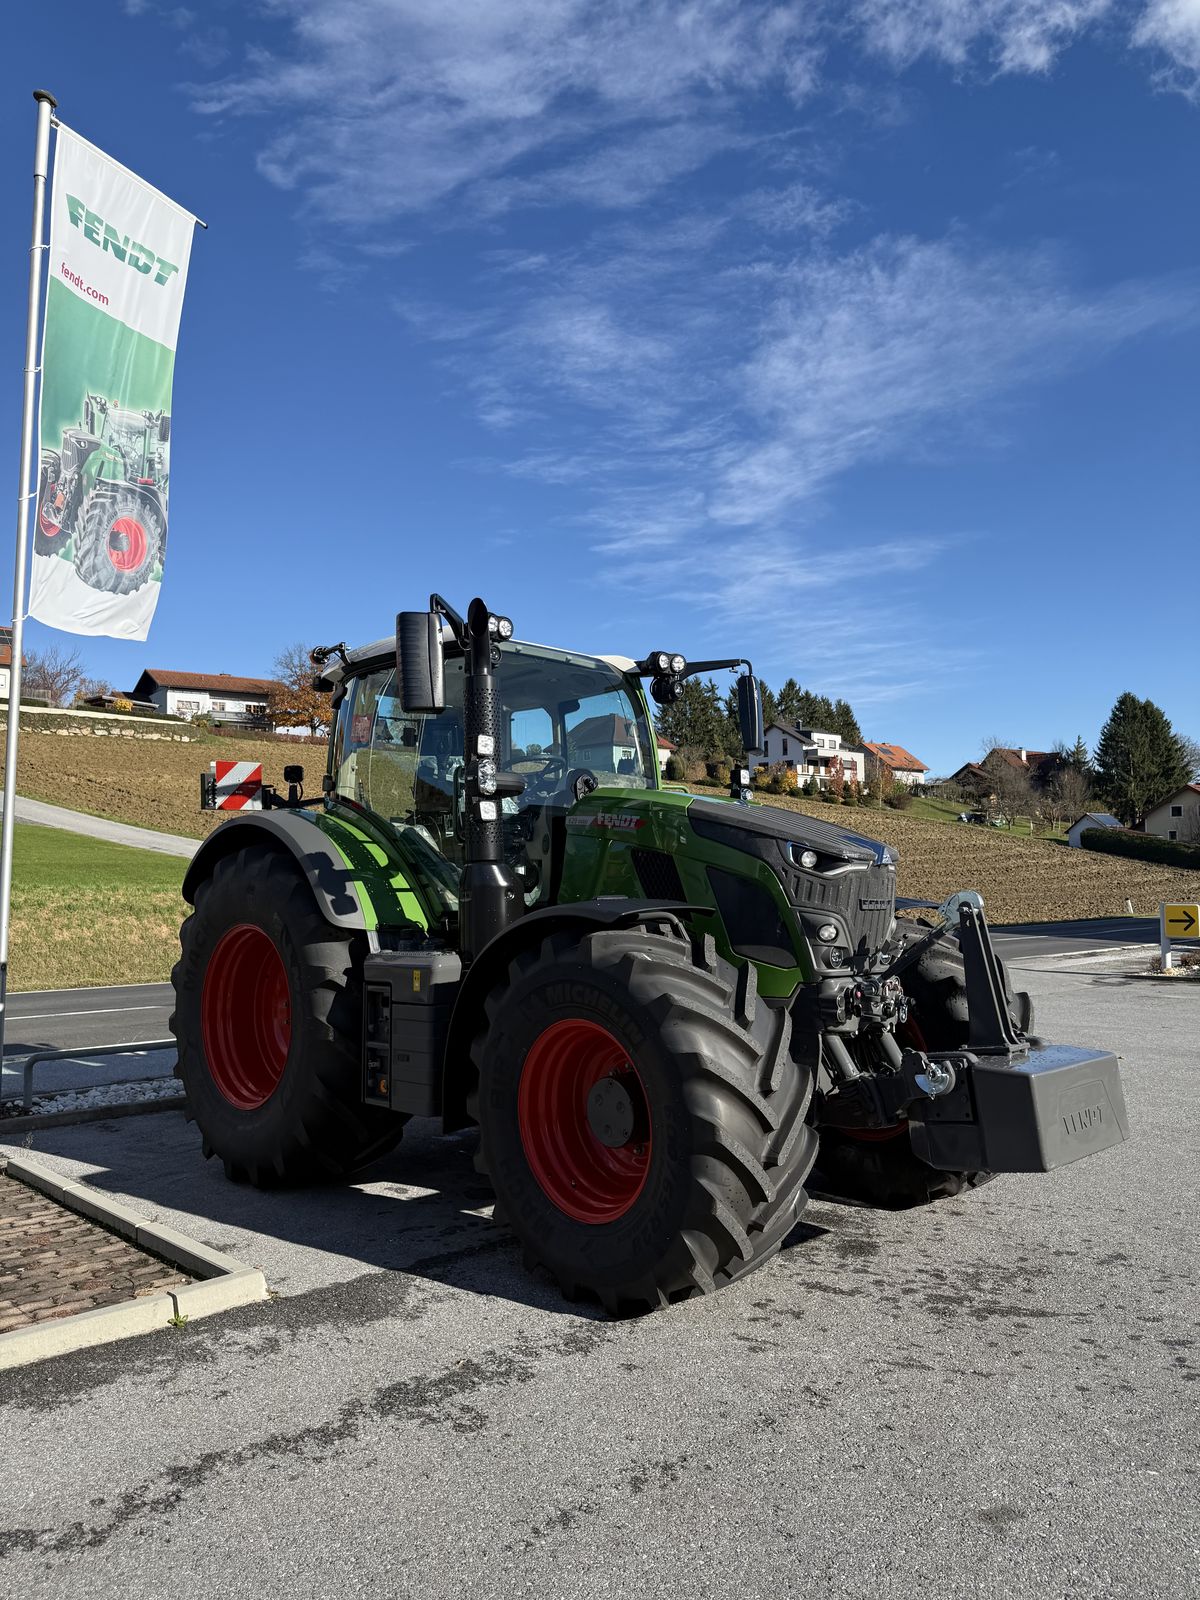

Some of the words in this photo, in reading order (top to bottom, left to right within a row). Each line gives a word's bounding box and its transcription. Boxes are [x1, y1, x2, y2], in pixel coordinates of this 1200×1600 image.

[65, 193, 179, 286] FENDT
[61, 262, 109, 306] fendt.com
[597, 812, 640, 828] FENDT
[545, 983, 645, 1046] MICHELIN
